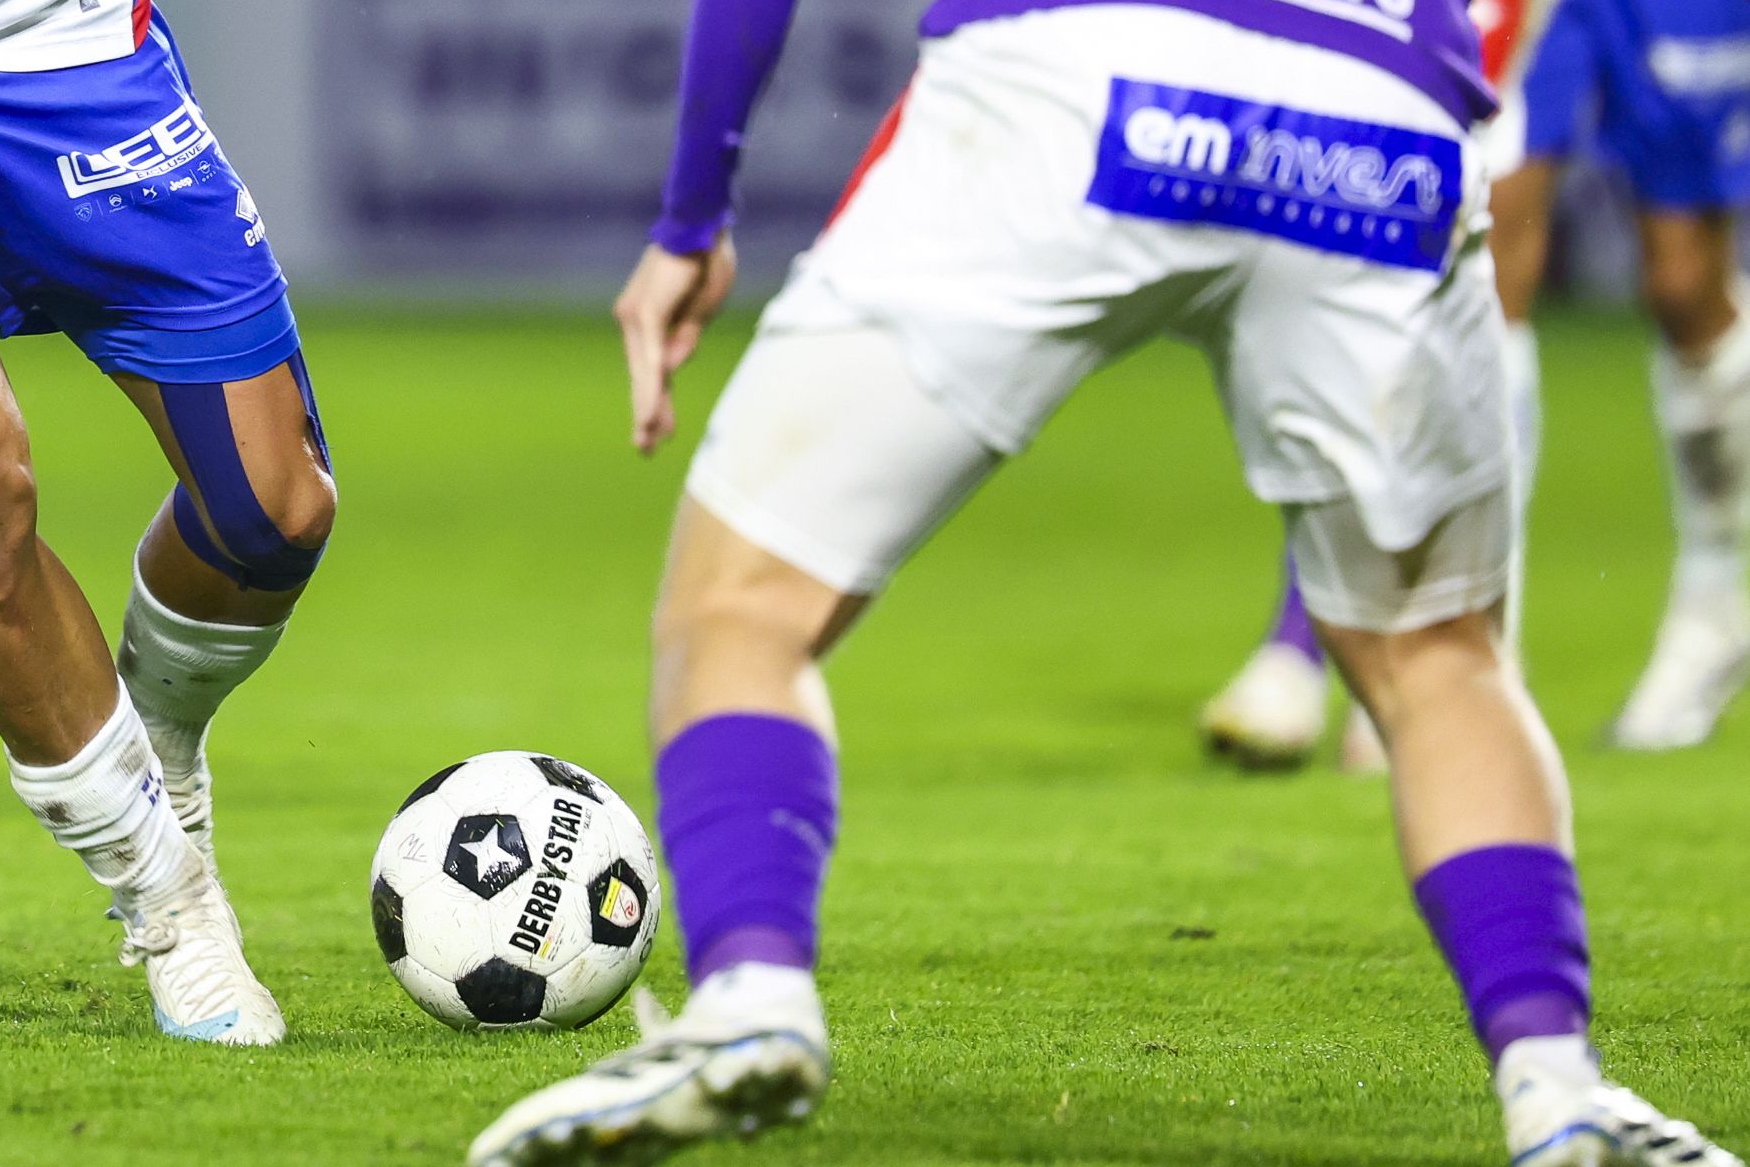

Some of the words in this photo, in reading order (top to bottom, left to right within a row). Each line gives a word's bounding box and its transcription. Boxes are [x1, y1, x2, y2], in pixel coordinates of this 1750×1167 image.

[56, 95, 210, 199] LEE
[136, 143, 204, 179] EXCLUSIVE
[508, 798, 583, 955] DERBYSTAR
